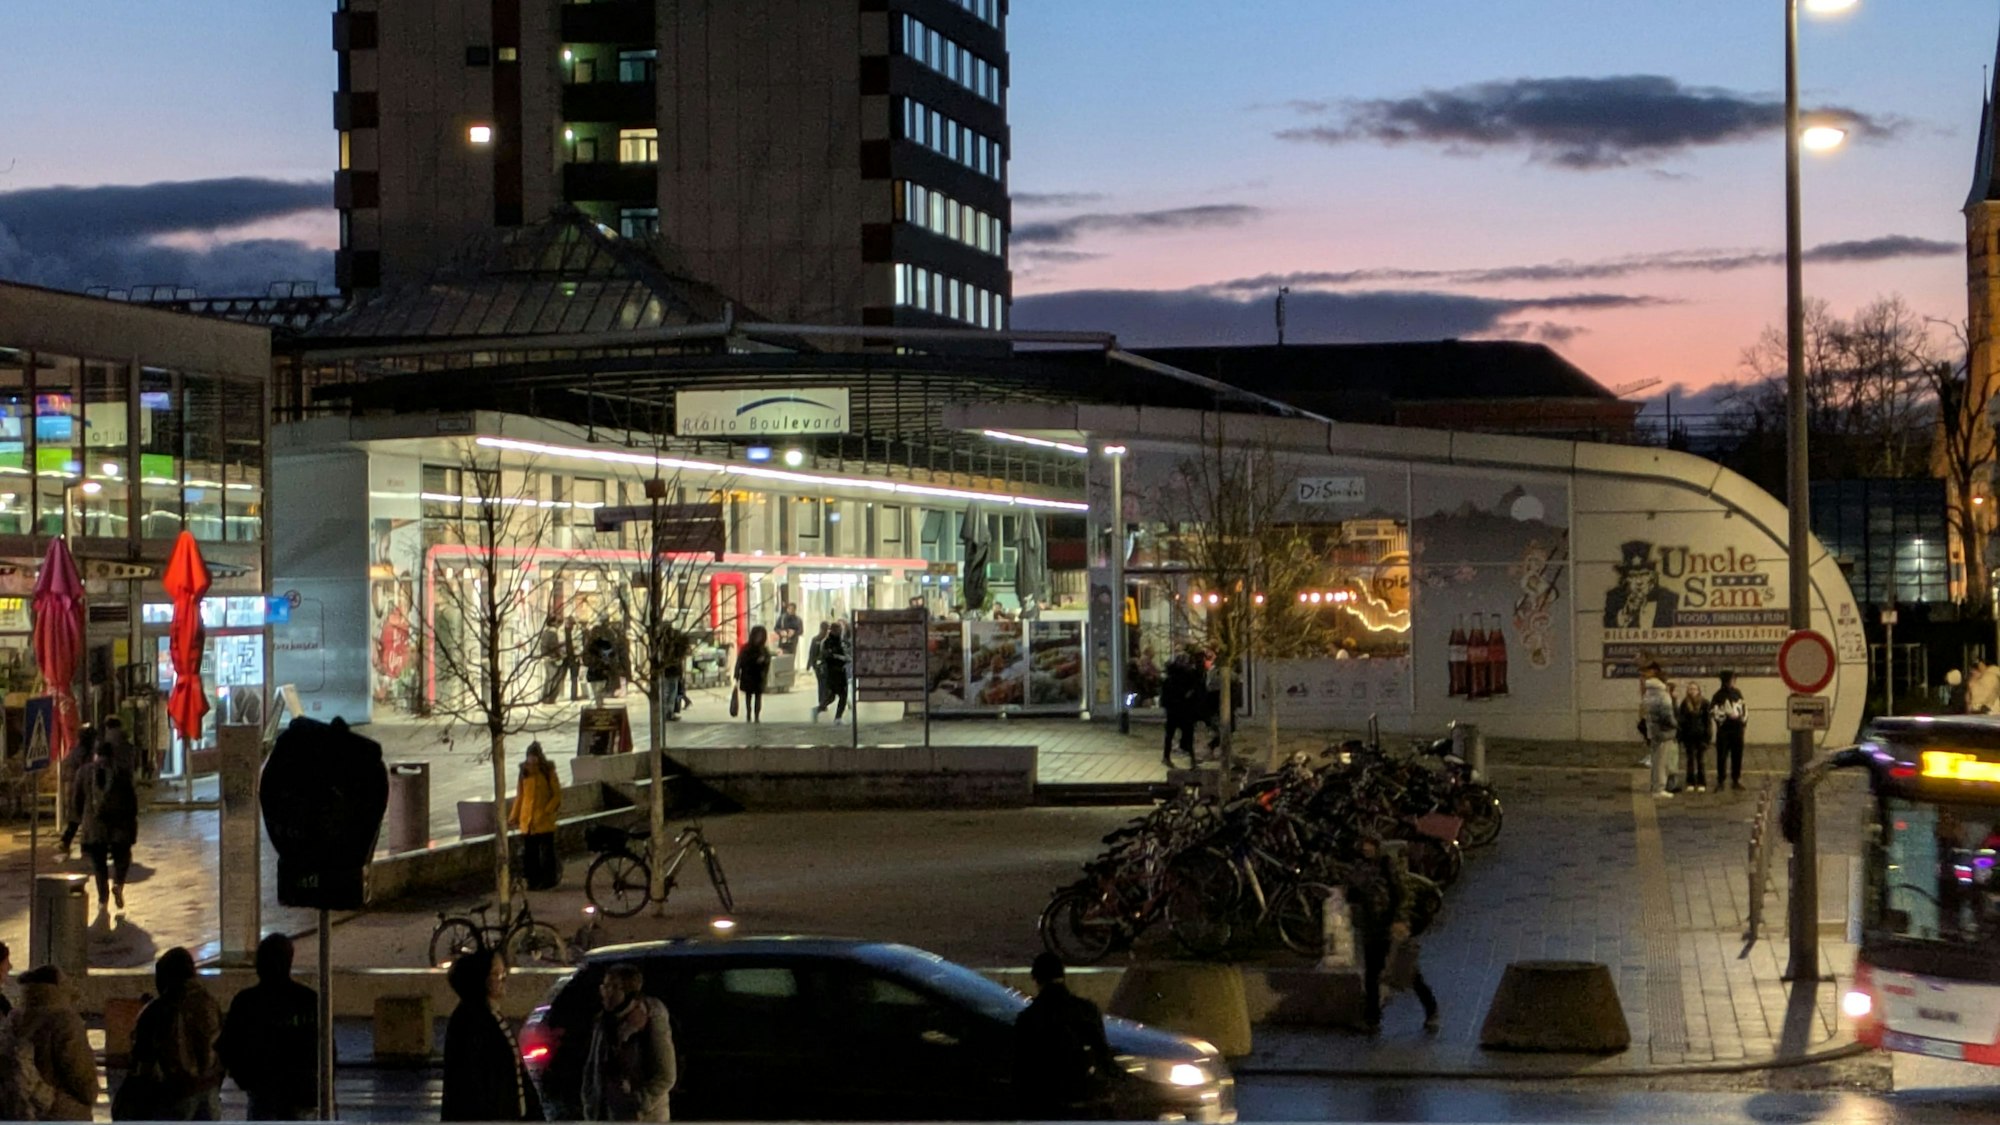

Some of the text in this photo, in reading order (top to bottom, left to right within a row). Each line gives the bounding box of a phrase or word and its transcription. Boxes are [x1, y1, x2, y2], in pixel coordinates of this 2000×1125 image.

[683, 415, 842, 431] Rialto Boulevard
[1657, 547, 1757, 578] Uncle
[1684, 576, 1775, 608] Sam's
[1678, 613, 1710, 624] FOOD,
[1712, 613, 1752, 623] DRINKS
[1763, 612, 1785, 622] FUN
[1604, 626, 1788, 640] BILLARD DART SPIELSTÄTTEN
[1608, 646, 1657, 657] AMERICN
[1695, 645, 1713, 656] BAR
[1725, 644, 1778, 656] RESTAURAN
